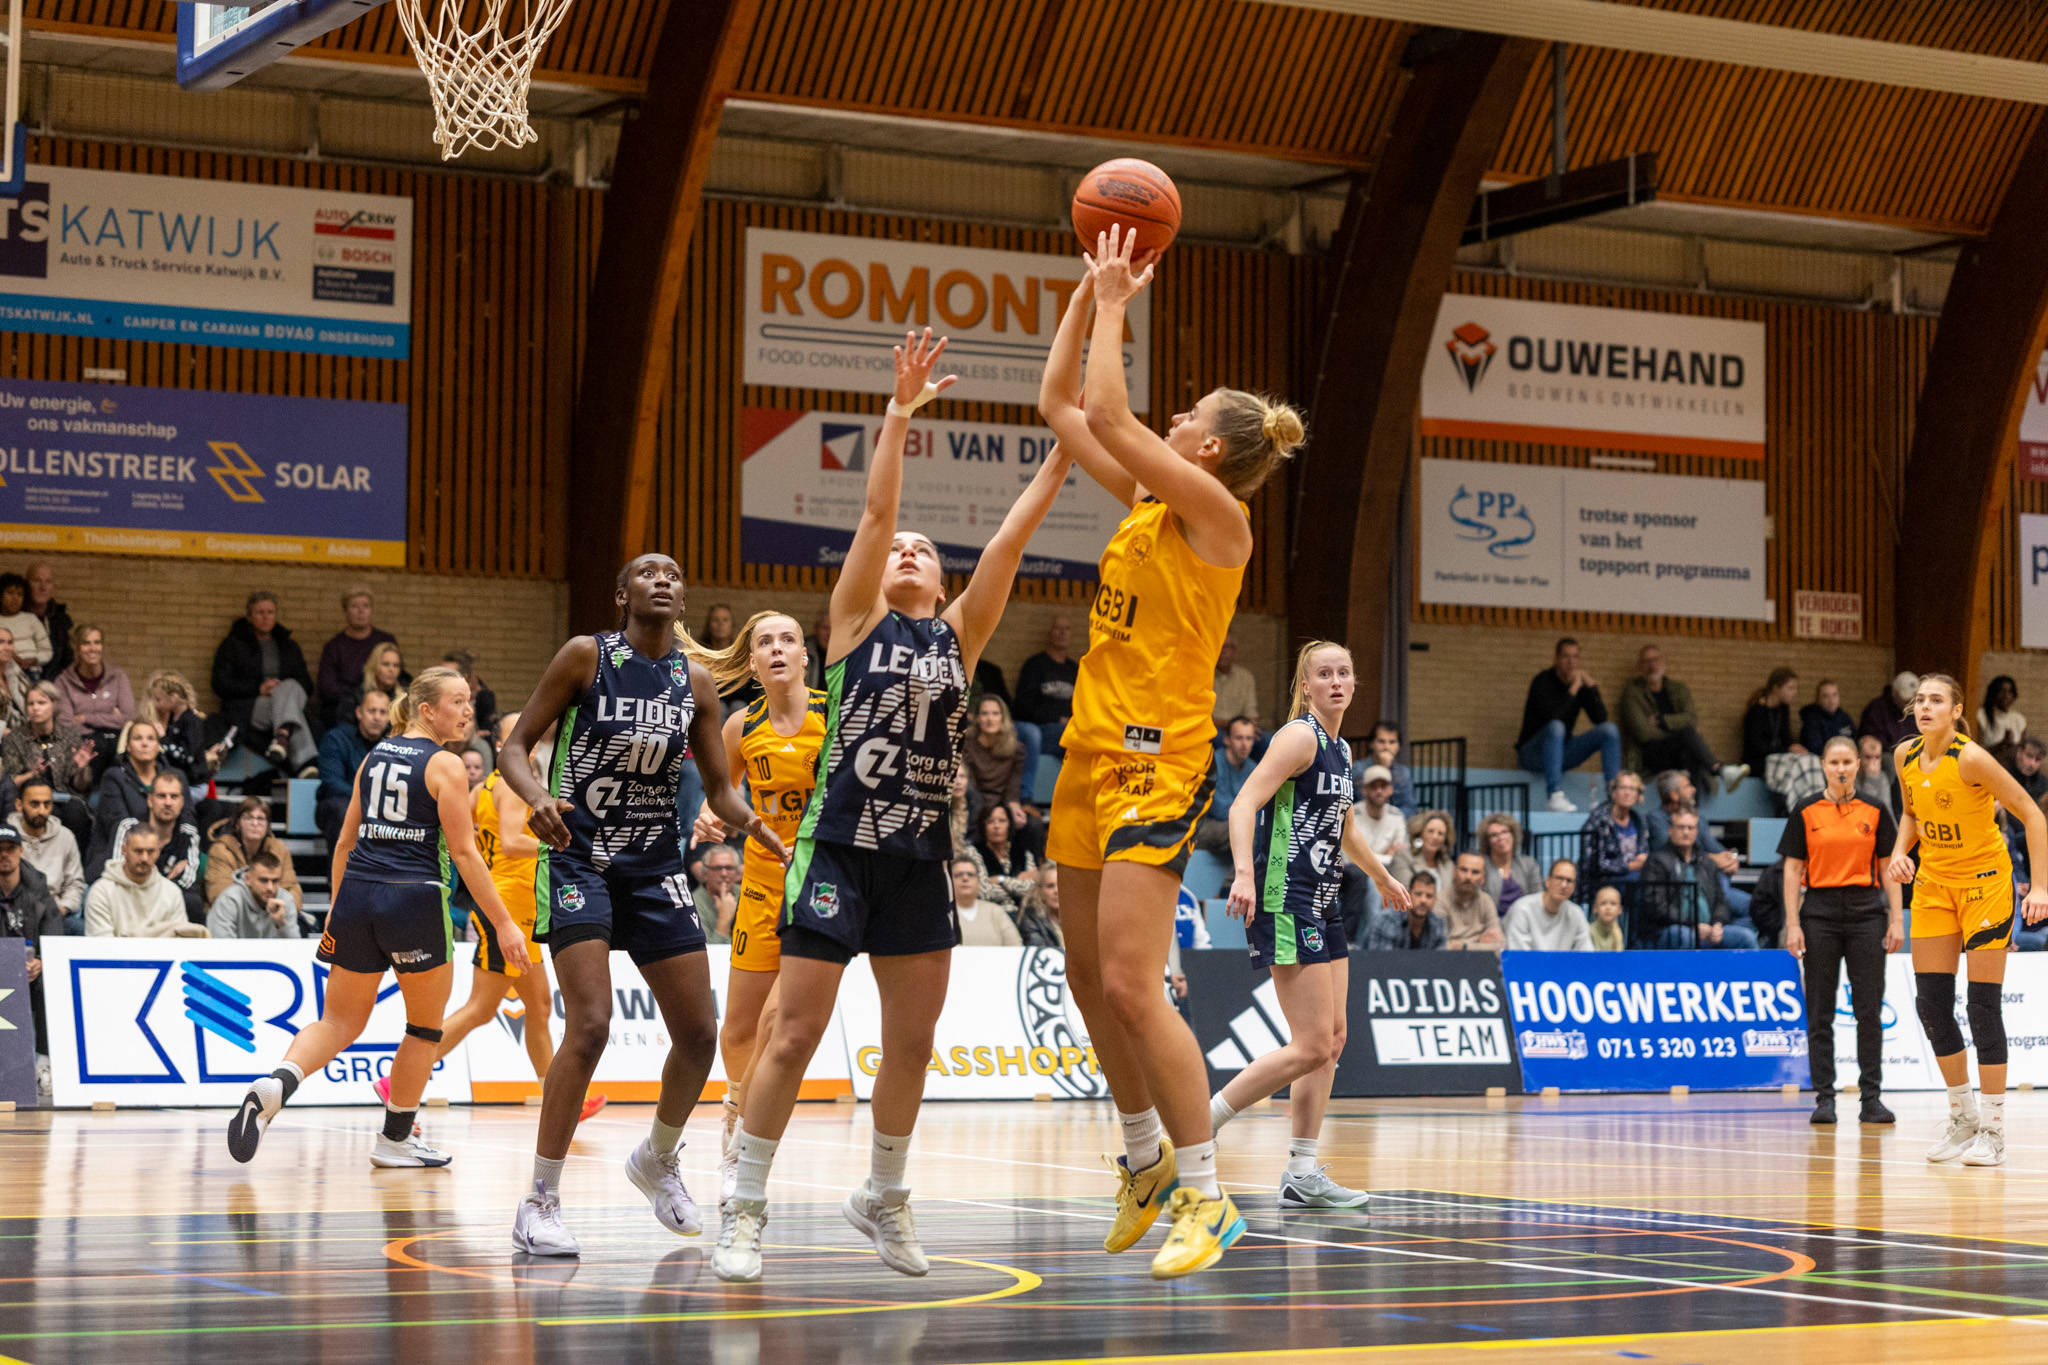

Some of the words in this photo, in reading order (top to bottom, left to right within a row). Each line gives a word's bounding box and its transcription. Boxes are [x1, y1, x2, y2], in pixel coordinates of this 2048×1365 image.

[314, 208, 350, 221] AUTO
[356, 209, 397, 225] CREW
[62, 204, 281, 262] KATWIJK
[60, 252, 92, 267] Auto
[96, 255, 105, 267] &
[111, 256, 148, 271] Truck
[152, 259, 201, 275] Service
[206, 264, 254, 280] Katwijk
[259, 267, 285, 281] B.V.
[341, 247, 393, 265] BOSCH
[761, 252, 1133, 343] ROMONT
[123, 315, 176, 331] CAMPER
[180, 319, 198, 332] EN
[202, 321, 260, 337] CARAVAN
[264, 323, 315, 341] BOVAG
[319, 330, 395, 348] ONDERHOUD
[758, 347, 804, 365] FOOD
[934, 364, 999, 381] TAINLESS
[1507, 335, 1745, 390] OUWEHAND
[29, 396, 97, 416] energie,
[1507, 381, 1589, 405] BOUWEN
[1610, 390, 1745, 417] ONTWIKKELEN
[27, 417, 58, 431] ons
[62, 418, 178, 442] vakmanschap
[947, 431, 1004, 462] VAN
[275, 461, 372, 492] SOLAR
[1476, 490, 1517, 519] PP
[1578, 507, 1630, 525] trotse
[1633, 511, 1698, 530] sponsor
[1578, 533, 1611, 549] van
[1614, 531, 1645, 550] het
[1578, 556, 1651, 577] topsport
[1655, 561, 1751, 582] programma
[1096, 583, 1138, 628] GBI
[1799, 595, 1860, 613] VERBODEN
[1799, 615, 1811, 634] TE
[1820, 618, 1860, 636] ROKEN
[868, 642, 967, 692] LEIDEN
[596, 695, 696, 736] LEIDEN
[913, 688, 932, 742] 1
[375, 741, 414, 756] macron
[627, 732, 669, 775] 10
[753, 755, 772, 781] 10
[366, 761, 412, 822] 15
[1924, 820, 1962, 841] GBI
[661, 873, 693, 909] 10
[733, 928, 748, 956] 10
[1368, 978, 1501, 1014] ADIDAS
[1509, 980, 1802, 1024] HOOGWERKERS
[1408, 1025, 1500, 1057] TEAM
[1597, 1037, 1636, 1060] 071
[1639, 1037, 1651, 1059] 5
[1653, 1037, 1697, 1059] 320
[1700, 1036, 1738, 1059] 123
